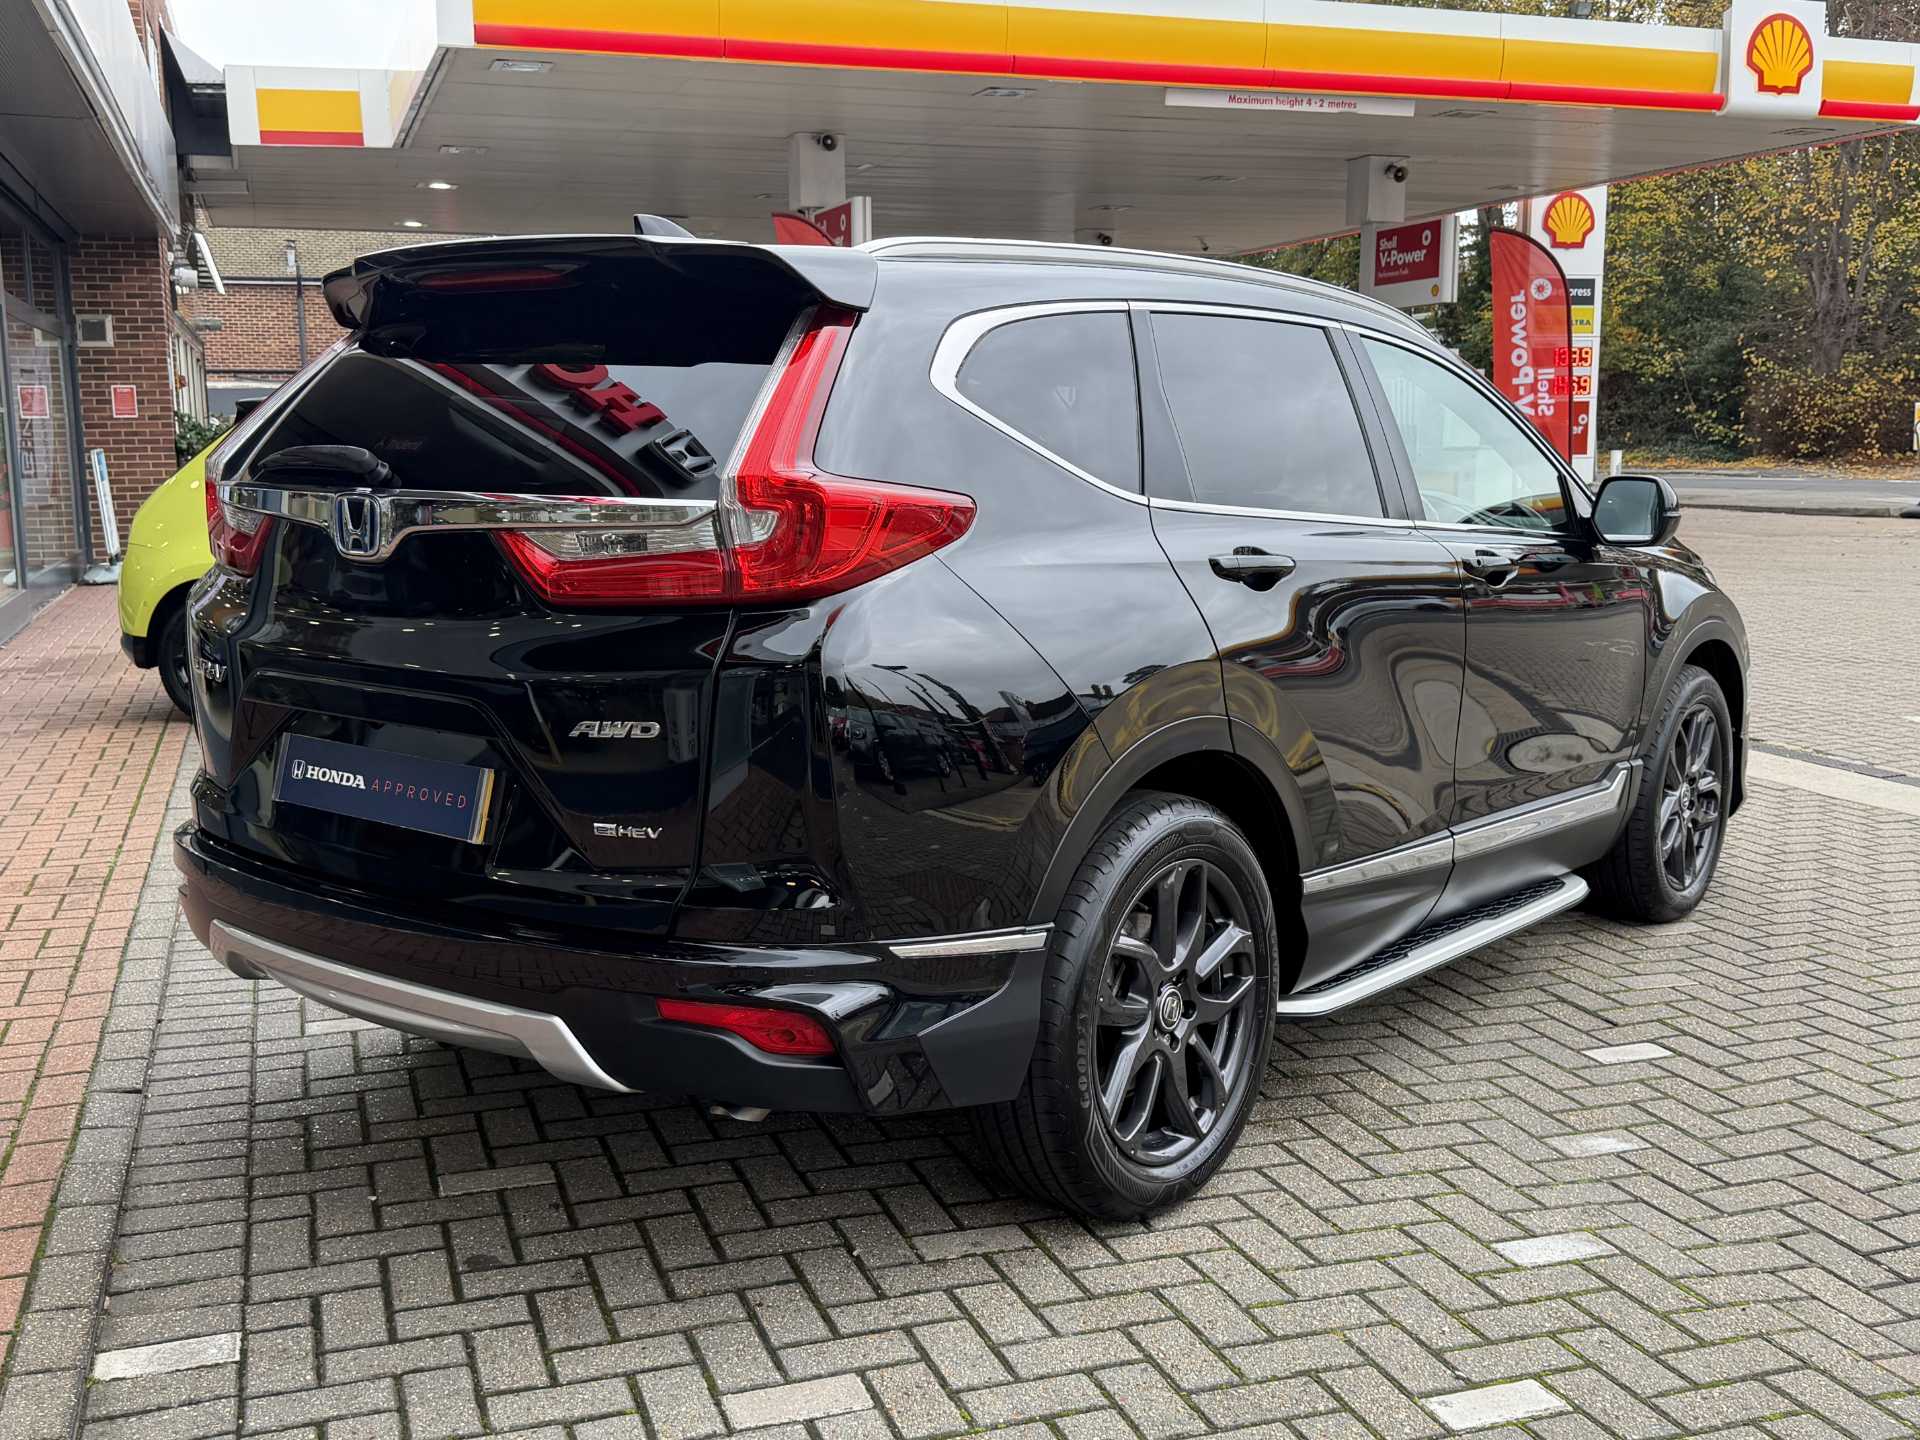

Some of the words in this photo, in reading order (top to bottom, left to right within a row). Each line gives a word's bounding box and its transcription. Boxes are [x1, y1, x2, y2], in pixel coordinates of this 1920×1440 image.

[1227, 94, 1274, 106] Maximum
[1275, 97, 1304, 109] height
[1327, 99, 1358, 110] metres
[1379, 235, 1398, 251] Shell
[1379, 248, 1427, 268] V-Power
[568, 720, 661, 739] AWD
[306, 764, 367, 790] HONDA
[370, 777, 468, 809] APPROVED
